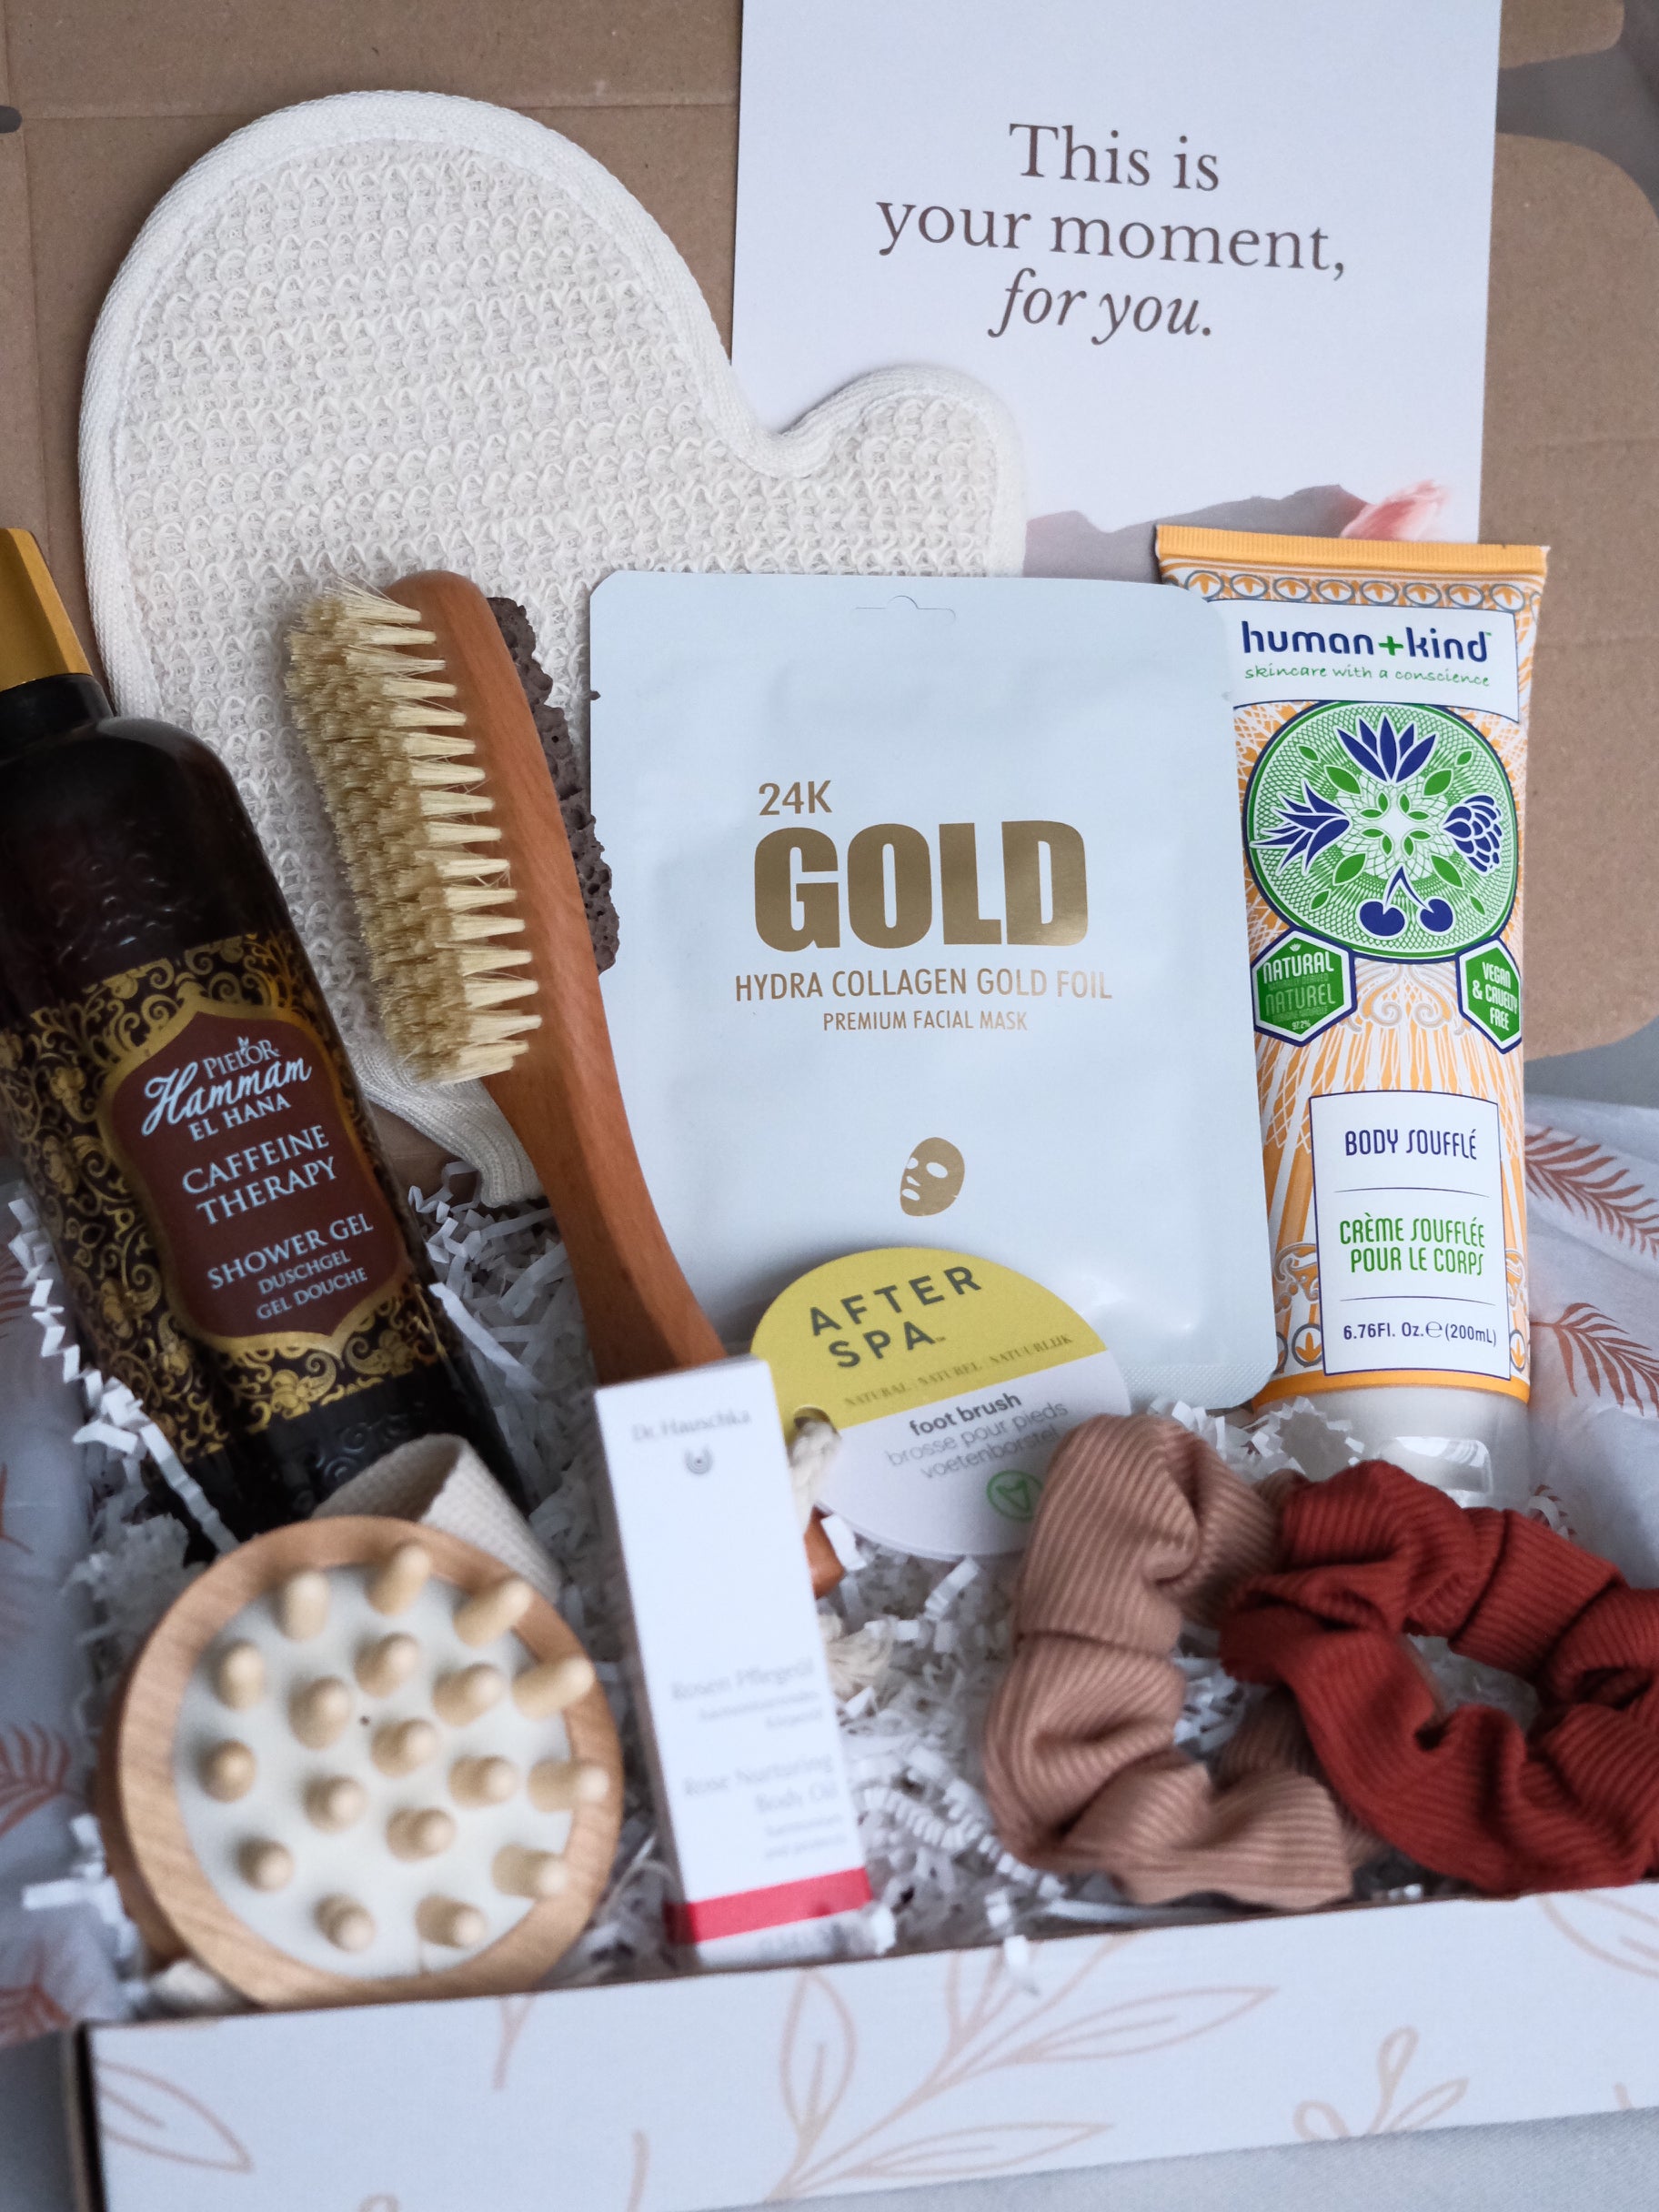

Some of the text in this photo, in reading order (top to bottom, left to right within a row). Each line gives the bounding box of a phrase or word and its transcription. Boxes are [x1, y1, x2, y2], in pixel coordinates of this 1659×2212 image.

[1010, 123, 1219, 191] This is
[876, 201, 1344, 280] your moment,
[988, 268, 1211, 345] for you.
[1244, 663, 1491, 687] skincare with a conscience
[759, 780, 832, 815] 24K
[755, 820, 1088, 952] GOLD
[736, 969, 1112, 1001] HYDRA COLLAGEN GOLD FOIL
[1263, 951, 1334, 984] NATURAL
[1482, 960, 1512, 990] VEGAN
[1265, 984, 1336, 1016] NATUREL
[1472, 980, 1518, 1015] & CRUELTY
[1489, 1006, 1510, 1031] FREE
[823, 1010, 1028, 1031] PREMIUM FACIAL MASK
[141, 1057, 312, 1136] Hammam
[188, 1092, 291, 1141] EL HANA
[182, 1124, 329, 1194] CAFFEINE
[1344, 1128, 1477, 1161] BODY SOUFFLÉ
[196, 1156, 337, 1225] THERAPY
[207, 1213, 374, 1290] SHOWER GEL
[1340, 1212, 1485, 1248] CRÈME SOUFFLÉE
[258, 1250, 351, 1294] DUSCHGEL
[1351, 1246, 1483, 1276] POUR LE CORPS
[256, 1267, 367, 1319] GEL DOUCHE
[809, 1266, 981, 1336] AFTER
[1445, 1323, 1497, 1347] (200mL)
[885, 1401, 1069, 1467] brosse pour pieds
[909, 1393, 1022, 1436] foot brush
[920, 1425, 1061, 1479] voetenborstel
